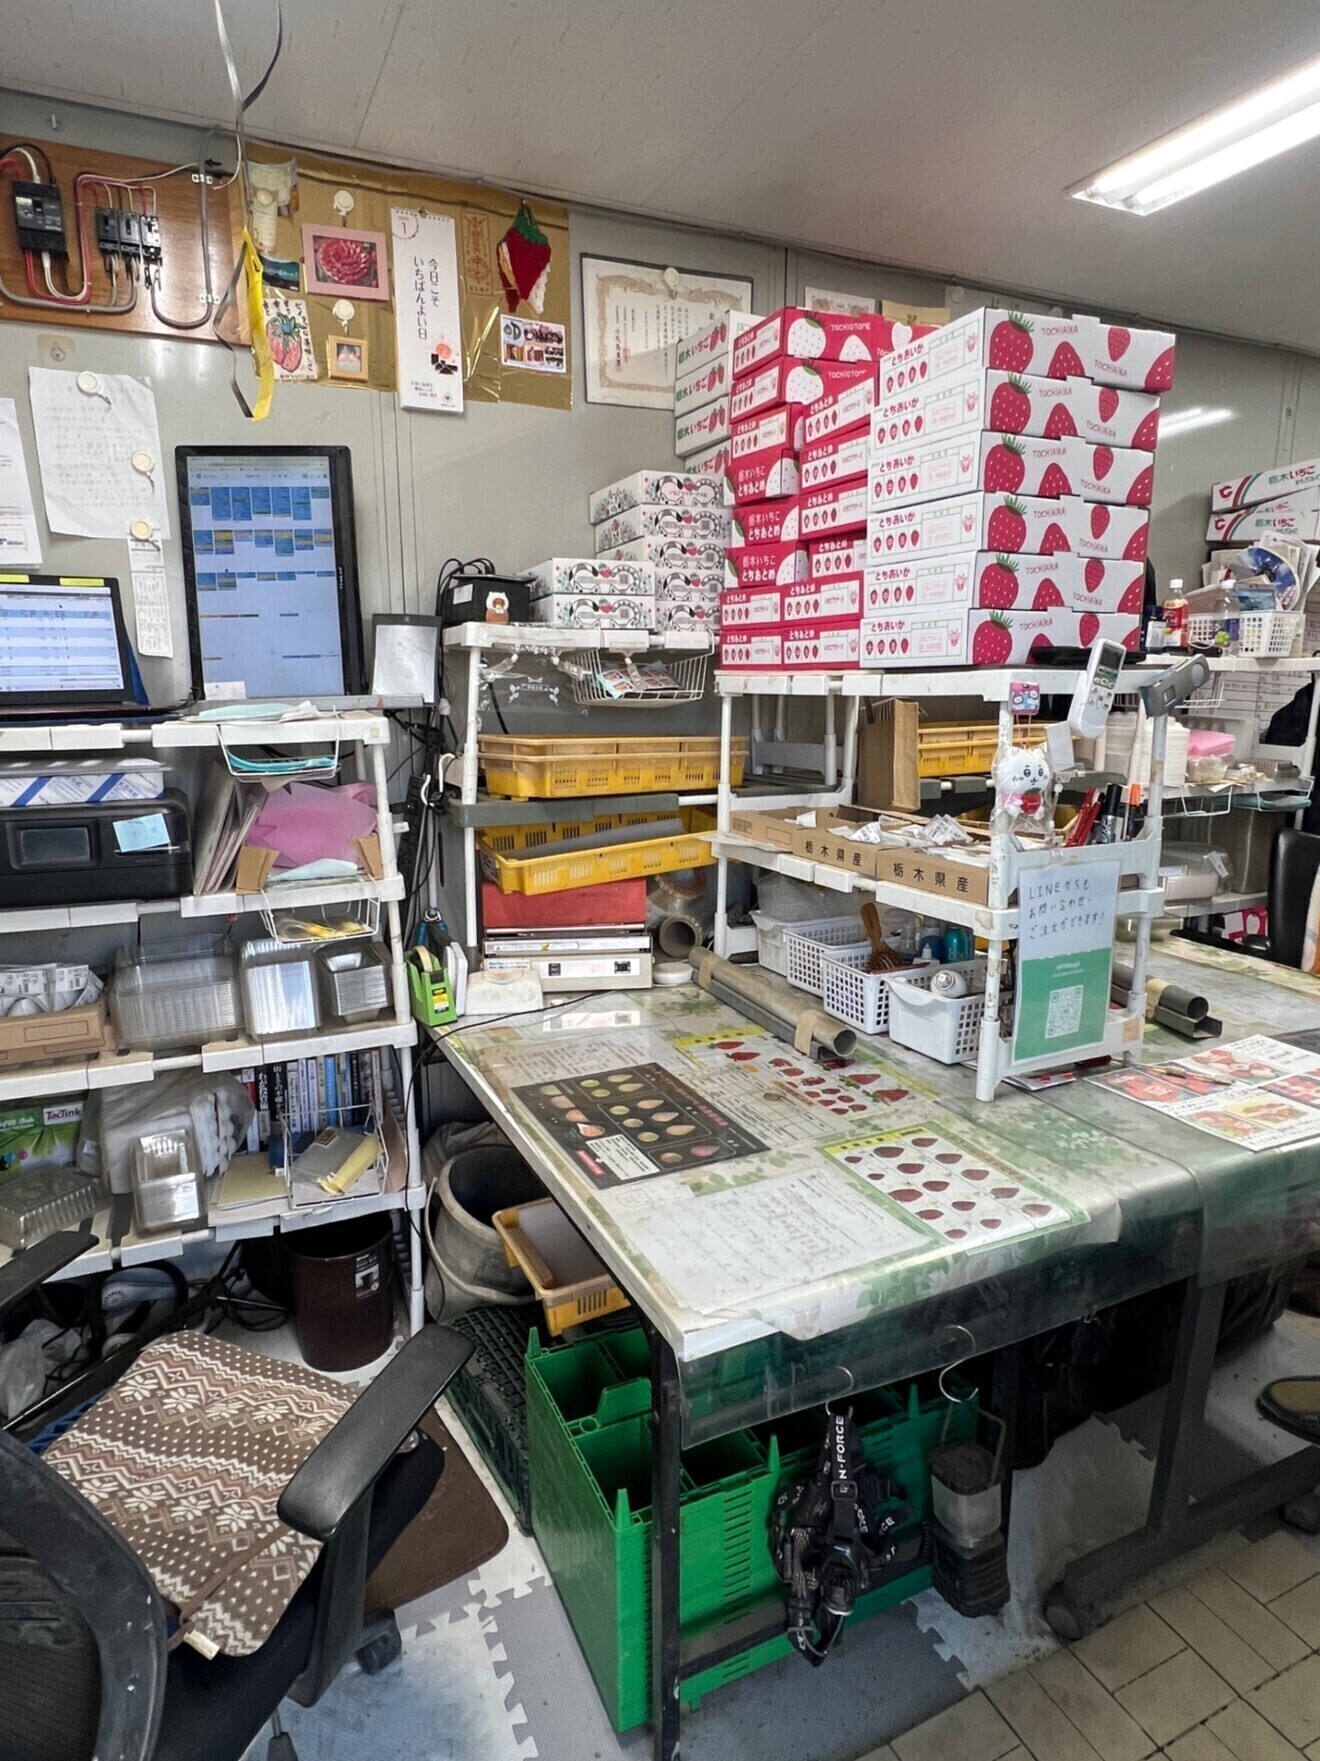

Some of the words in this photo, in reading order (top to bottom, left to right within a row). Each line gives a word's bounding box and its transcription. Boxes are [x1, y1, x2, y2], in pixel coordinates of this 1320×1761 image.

[428, 258, 440, 307] 今日こそ
[413, 256, 427, 340] いちばんよい日
[830, 322, 871, 332] TOCHIOTOME
[1041, 325, 1079, 336] TOCHIAIKA
[678, 334, 711, 363] 栃木いちご
[891, 343, 924, 366] とちあいか
[828, 369, 866, 379] TOCHIOTO
[1094, 359, 1128, 377] TOCHIAIKA
[675, 375, 708, 402] 栃木いちご
[1039, 387, 1073, 397] TOCHIAIKA
[810, 396, 834, 414] とちおとめ
[883, 397, 919, 418] とちあいか
[677, 416, 710, 440] 栃木いちご
[1086, 420, 1117, 437] TOCHIAIKA
[807, 444, 834, 461] とちおとめ
[1032, 448, 1067, 458] TOCHIAIKA
[879, 455, 915, 472] とちあいか
[1268, 464, 1316, 484] 栃木いちご
[1080, 478, 1112, 495] TOCHIAIKA
[807, 492, 834, 507] とちおとめ
[748, 511, 781, 527] 栃木いちご
[878, 512, 915, 528] とちあいか
[1033, 508, 1066, 519] TOCHIAIKA
[1255, 517, 1296, 528] 栃木いちご
[748, 525, 781, 541] とちおとめ
[818, 540, 848, 554] とちおとめ
[1079, 537, 1109, 553] TOCHIAIKA
[742, 555, 776, 568] 栃木いちご
[1026, 563, 1059, 574] TOCHIAIKA
[742, 567, 776, 582] とちおとめ
[875, 566, 911, 581] とちあいか
[790, 583, 816, 597] とちおとめ
[1072, 592, 1103, 606] TOCHIAIKA
[871, 619, 905, 632] とちあいか
[1019, 618, 1054, 630] TOCHIAIKA
[789, 629, 815, 641] とちおとめ
[805, 840, 862, 867] 栃木県産
[893, 862, 969, 893] 栃木県産
[1029, 879, 1090, 900] LINEからも
[46, 1108, 81, 1121] TacTink
